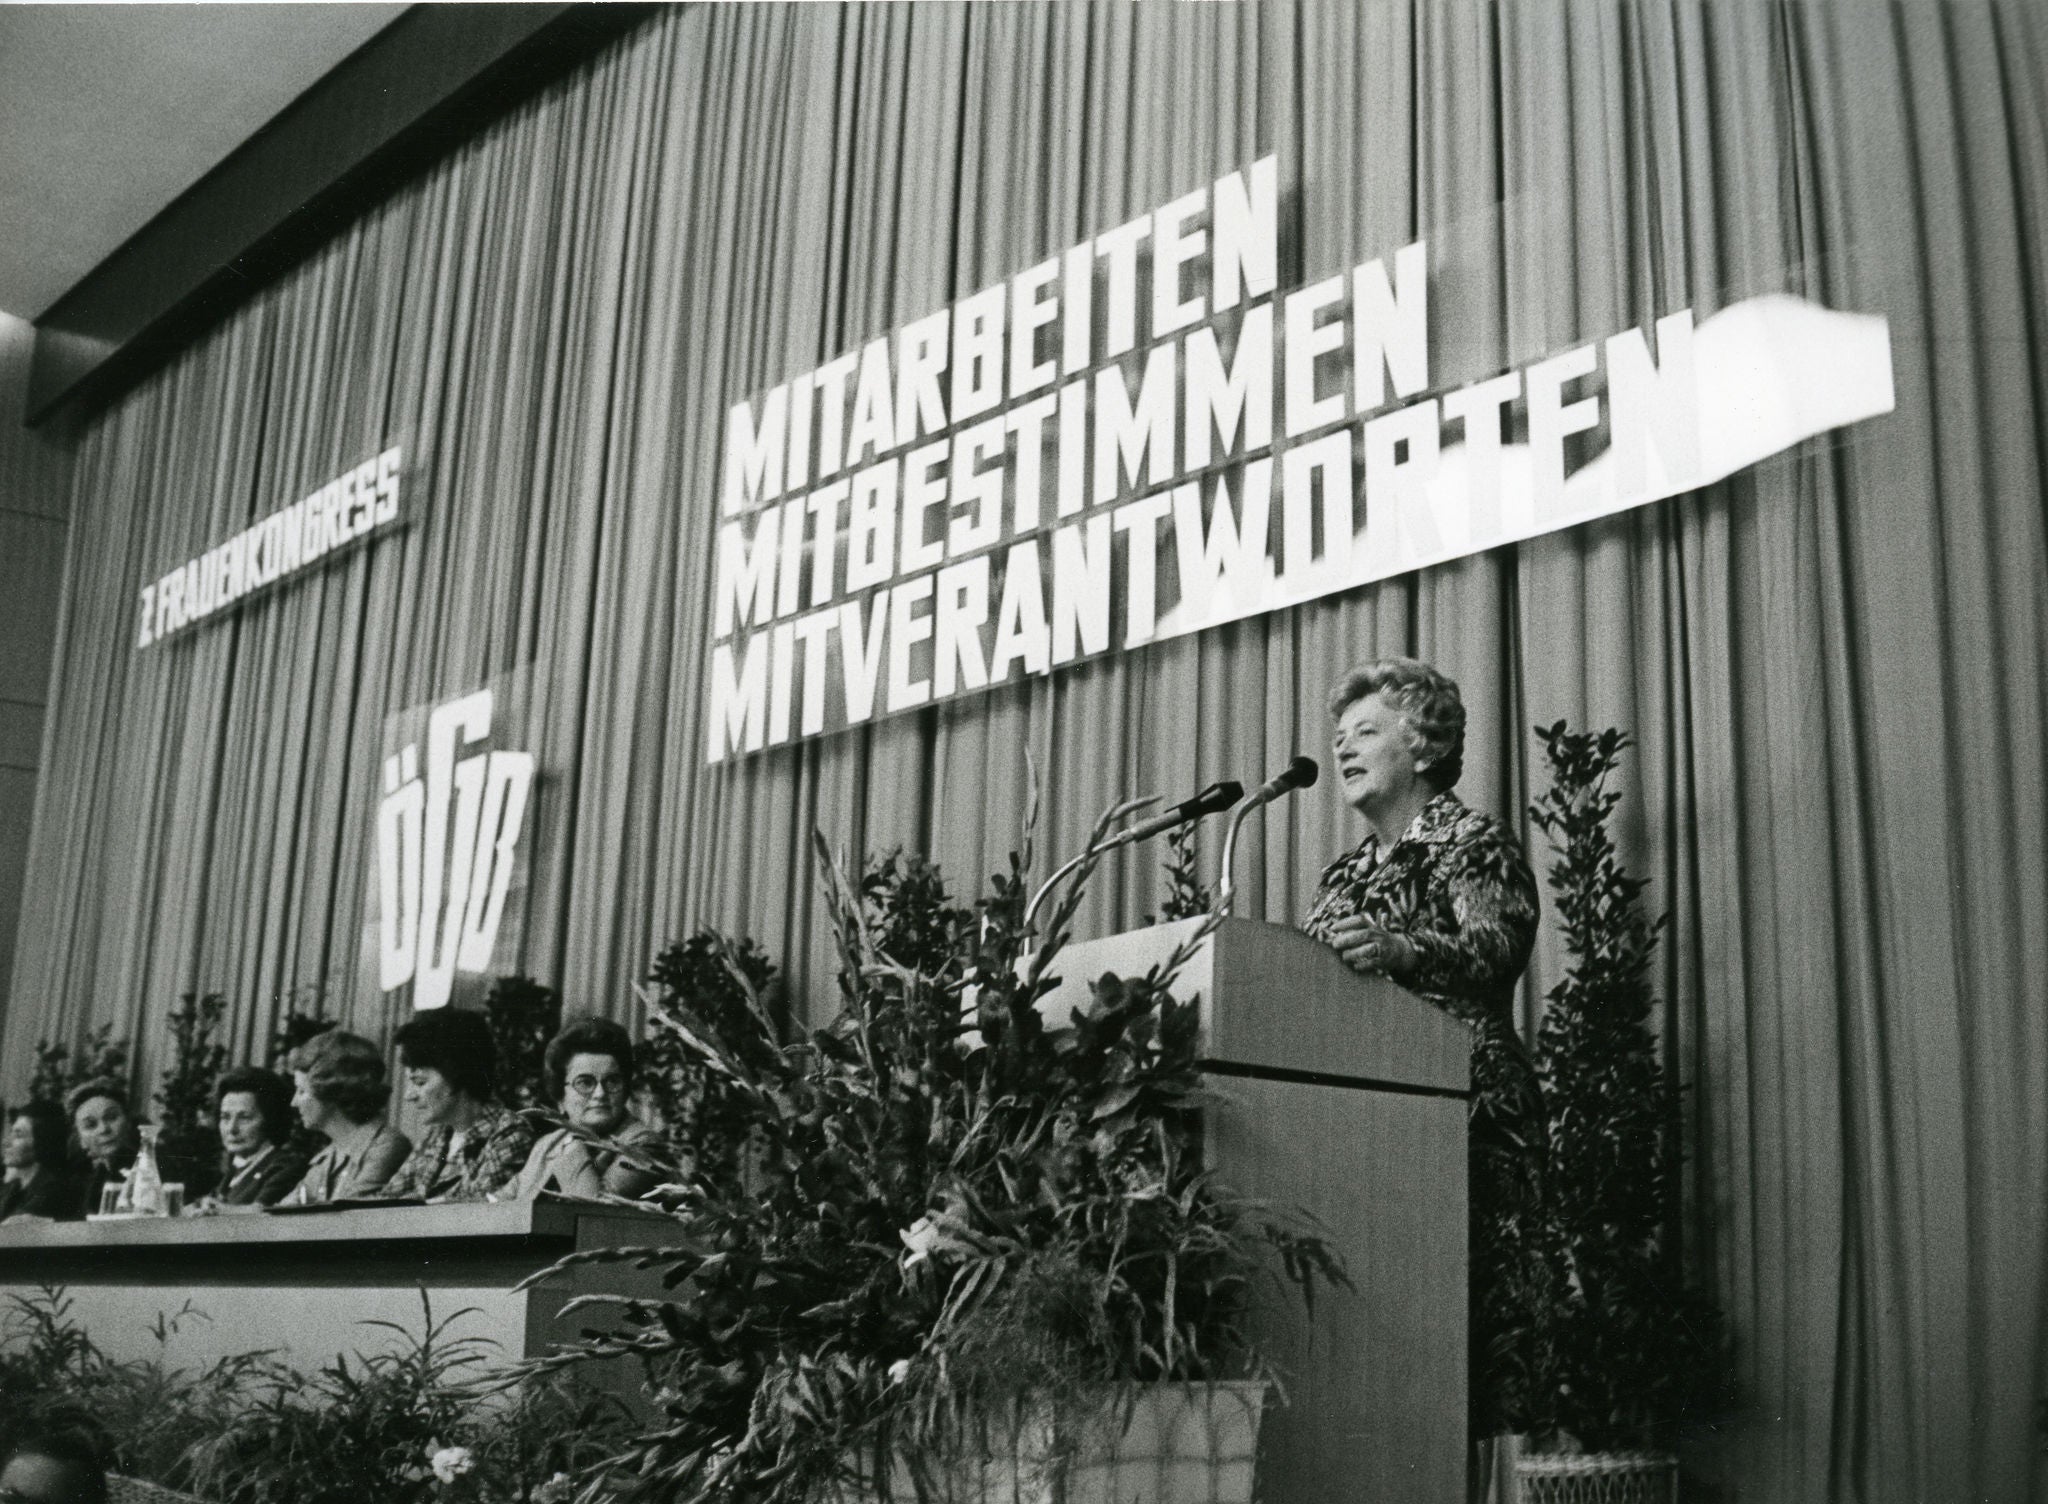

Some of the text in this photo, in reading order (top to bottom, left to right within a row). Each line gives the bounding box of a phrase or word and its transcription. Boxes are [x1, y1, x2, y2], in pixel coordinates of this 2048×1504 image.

[714, 241, 1428, 640] MITBESTIMMEN
[723, 153, 1278, 518] MITARBEITEN
[707, 308, 1701, 765] MITVERANTWORTEN
[378, 688, 534, 1012] ÖGB
